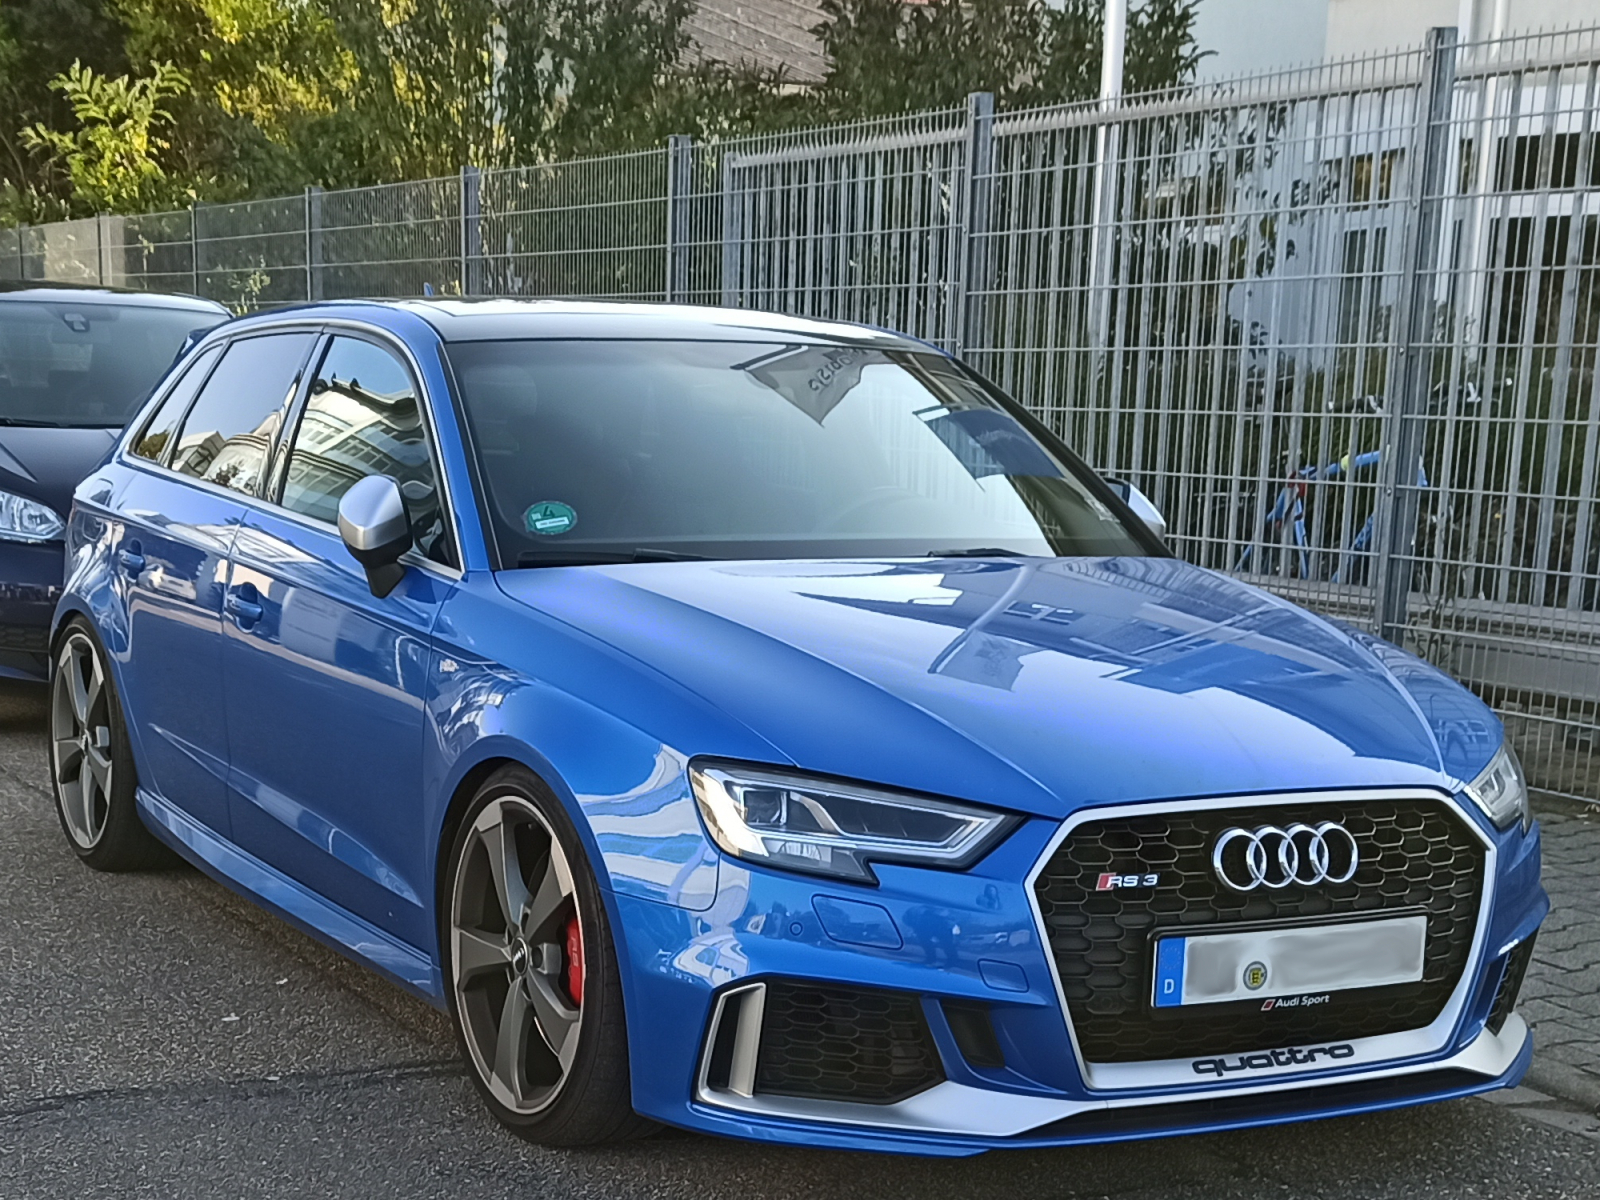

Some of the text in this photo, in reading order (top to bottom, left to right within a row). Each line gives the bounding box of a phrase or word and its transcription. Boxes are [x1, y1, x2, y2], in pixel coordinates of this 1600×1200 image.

[542, 505, 556, 518] 4
[1105, 873, 1159, 888] RS 3
[1163, 978, 1175, 995] D
[1275, 994, 1330, 1009] Audi Sport
[1192, 1043, 1355, 1078] quattro
